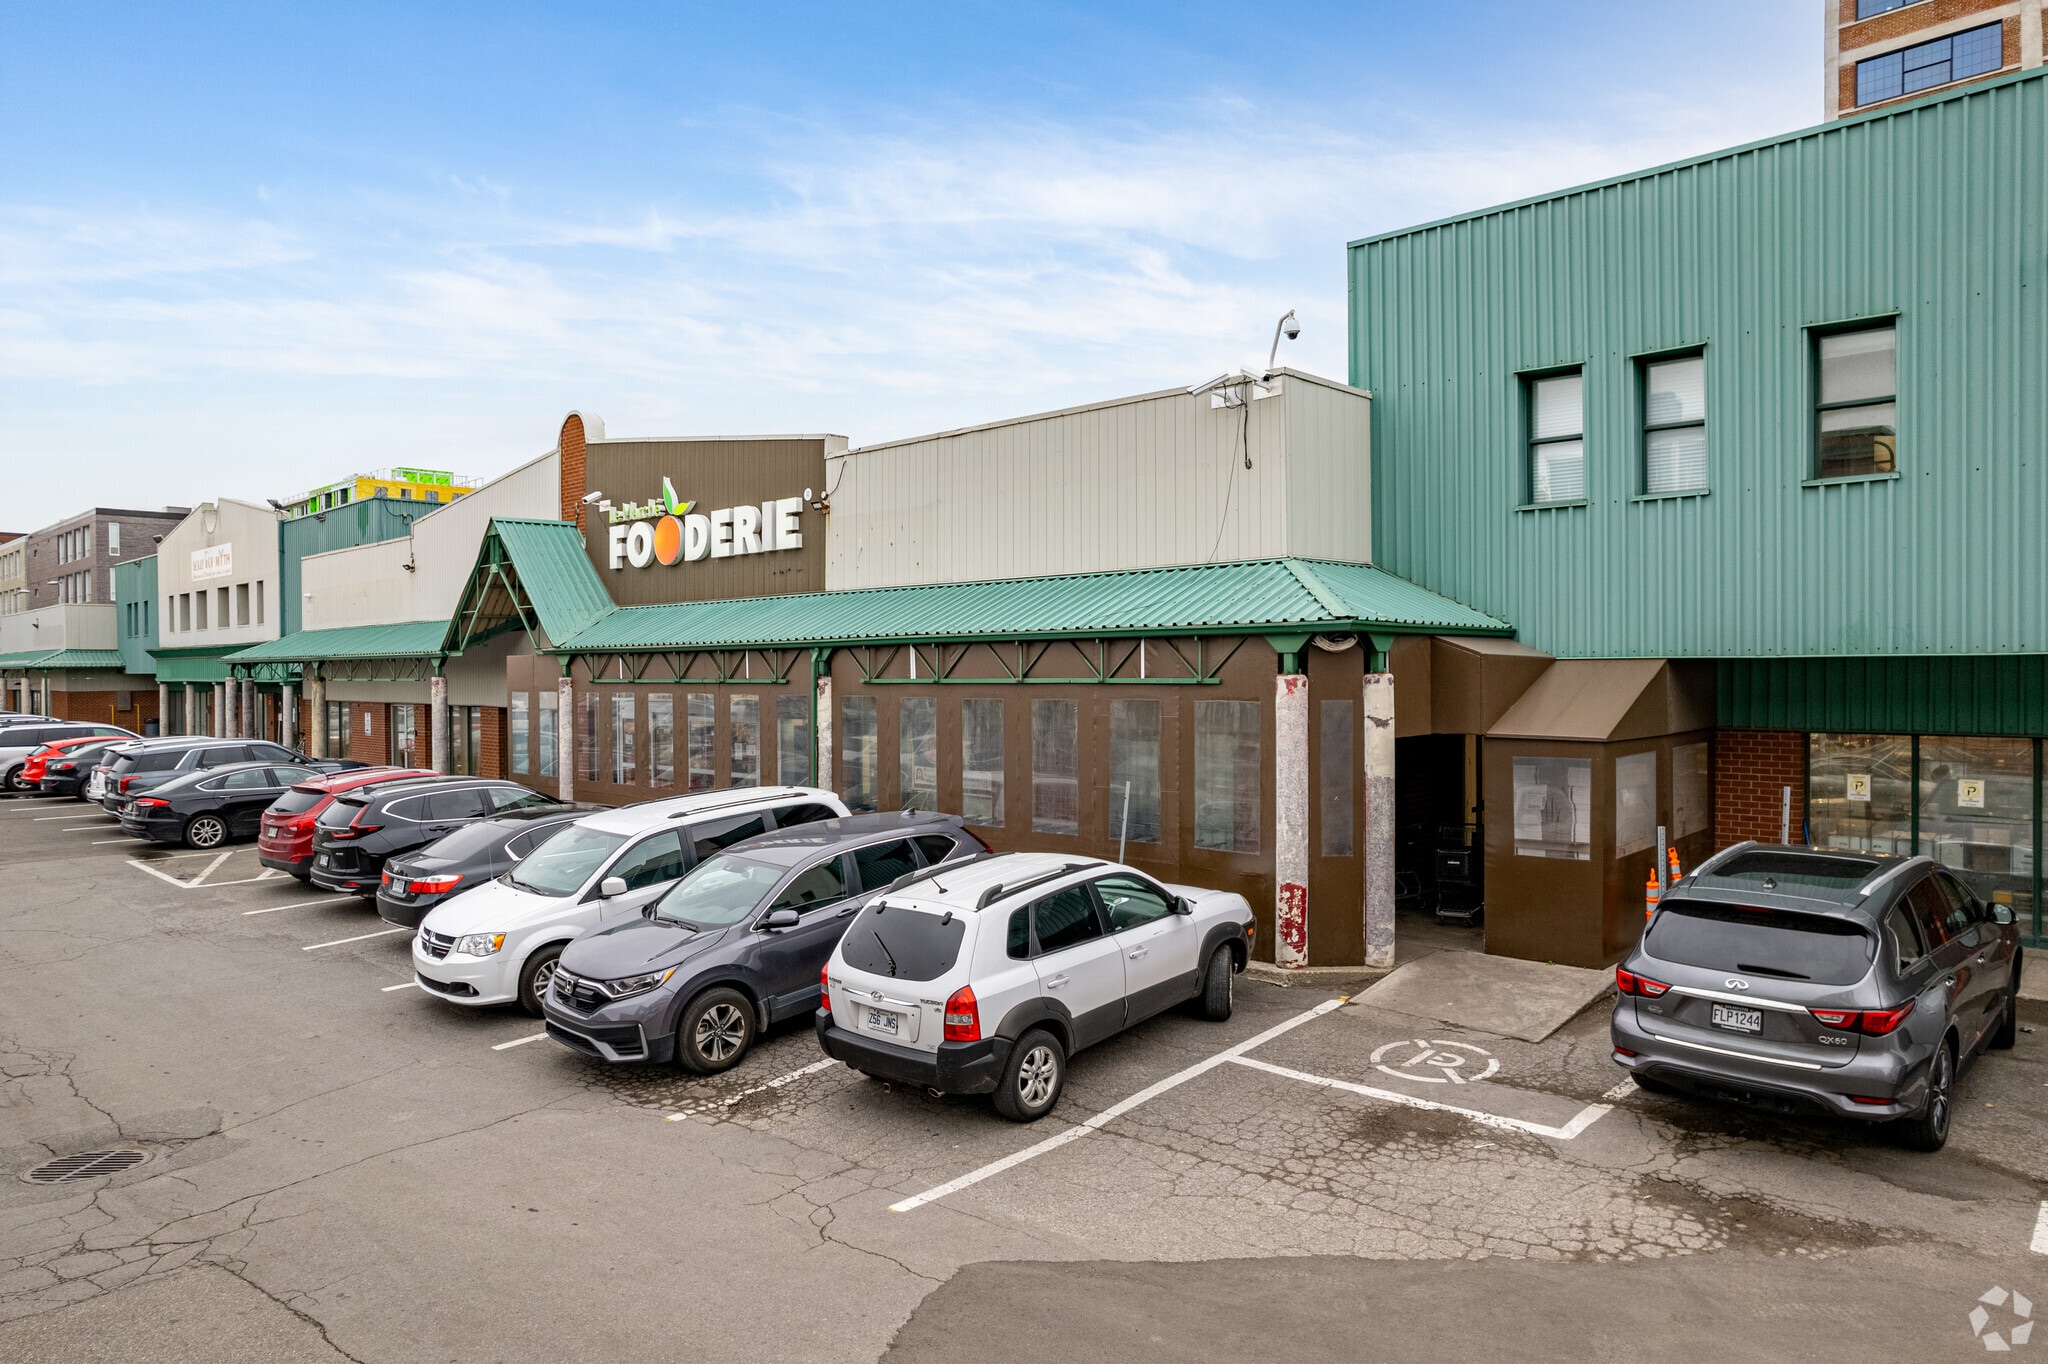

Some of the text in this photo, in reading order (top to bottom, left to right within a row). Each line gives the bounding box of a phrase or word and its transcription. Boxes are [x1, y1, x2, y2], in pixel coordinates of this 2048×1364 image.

[609, 506, 624, 524] Le
[609, 497, 803, 570] FOODERIE
[868, 1013, 881, 1025] Z56
[1713, 1008, 1760, 1028] FLP1244
[1818, 1035, 1848, 1045] QX60
